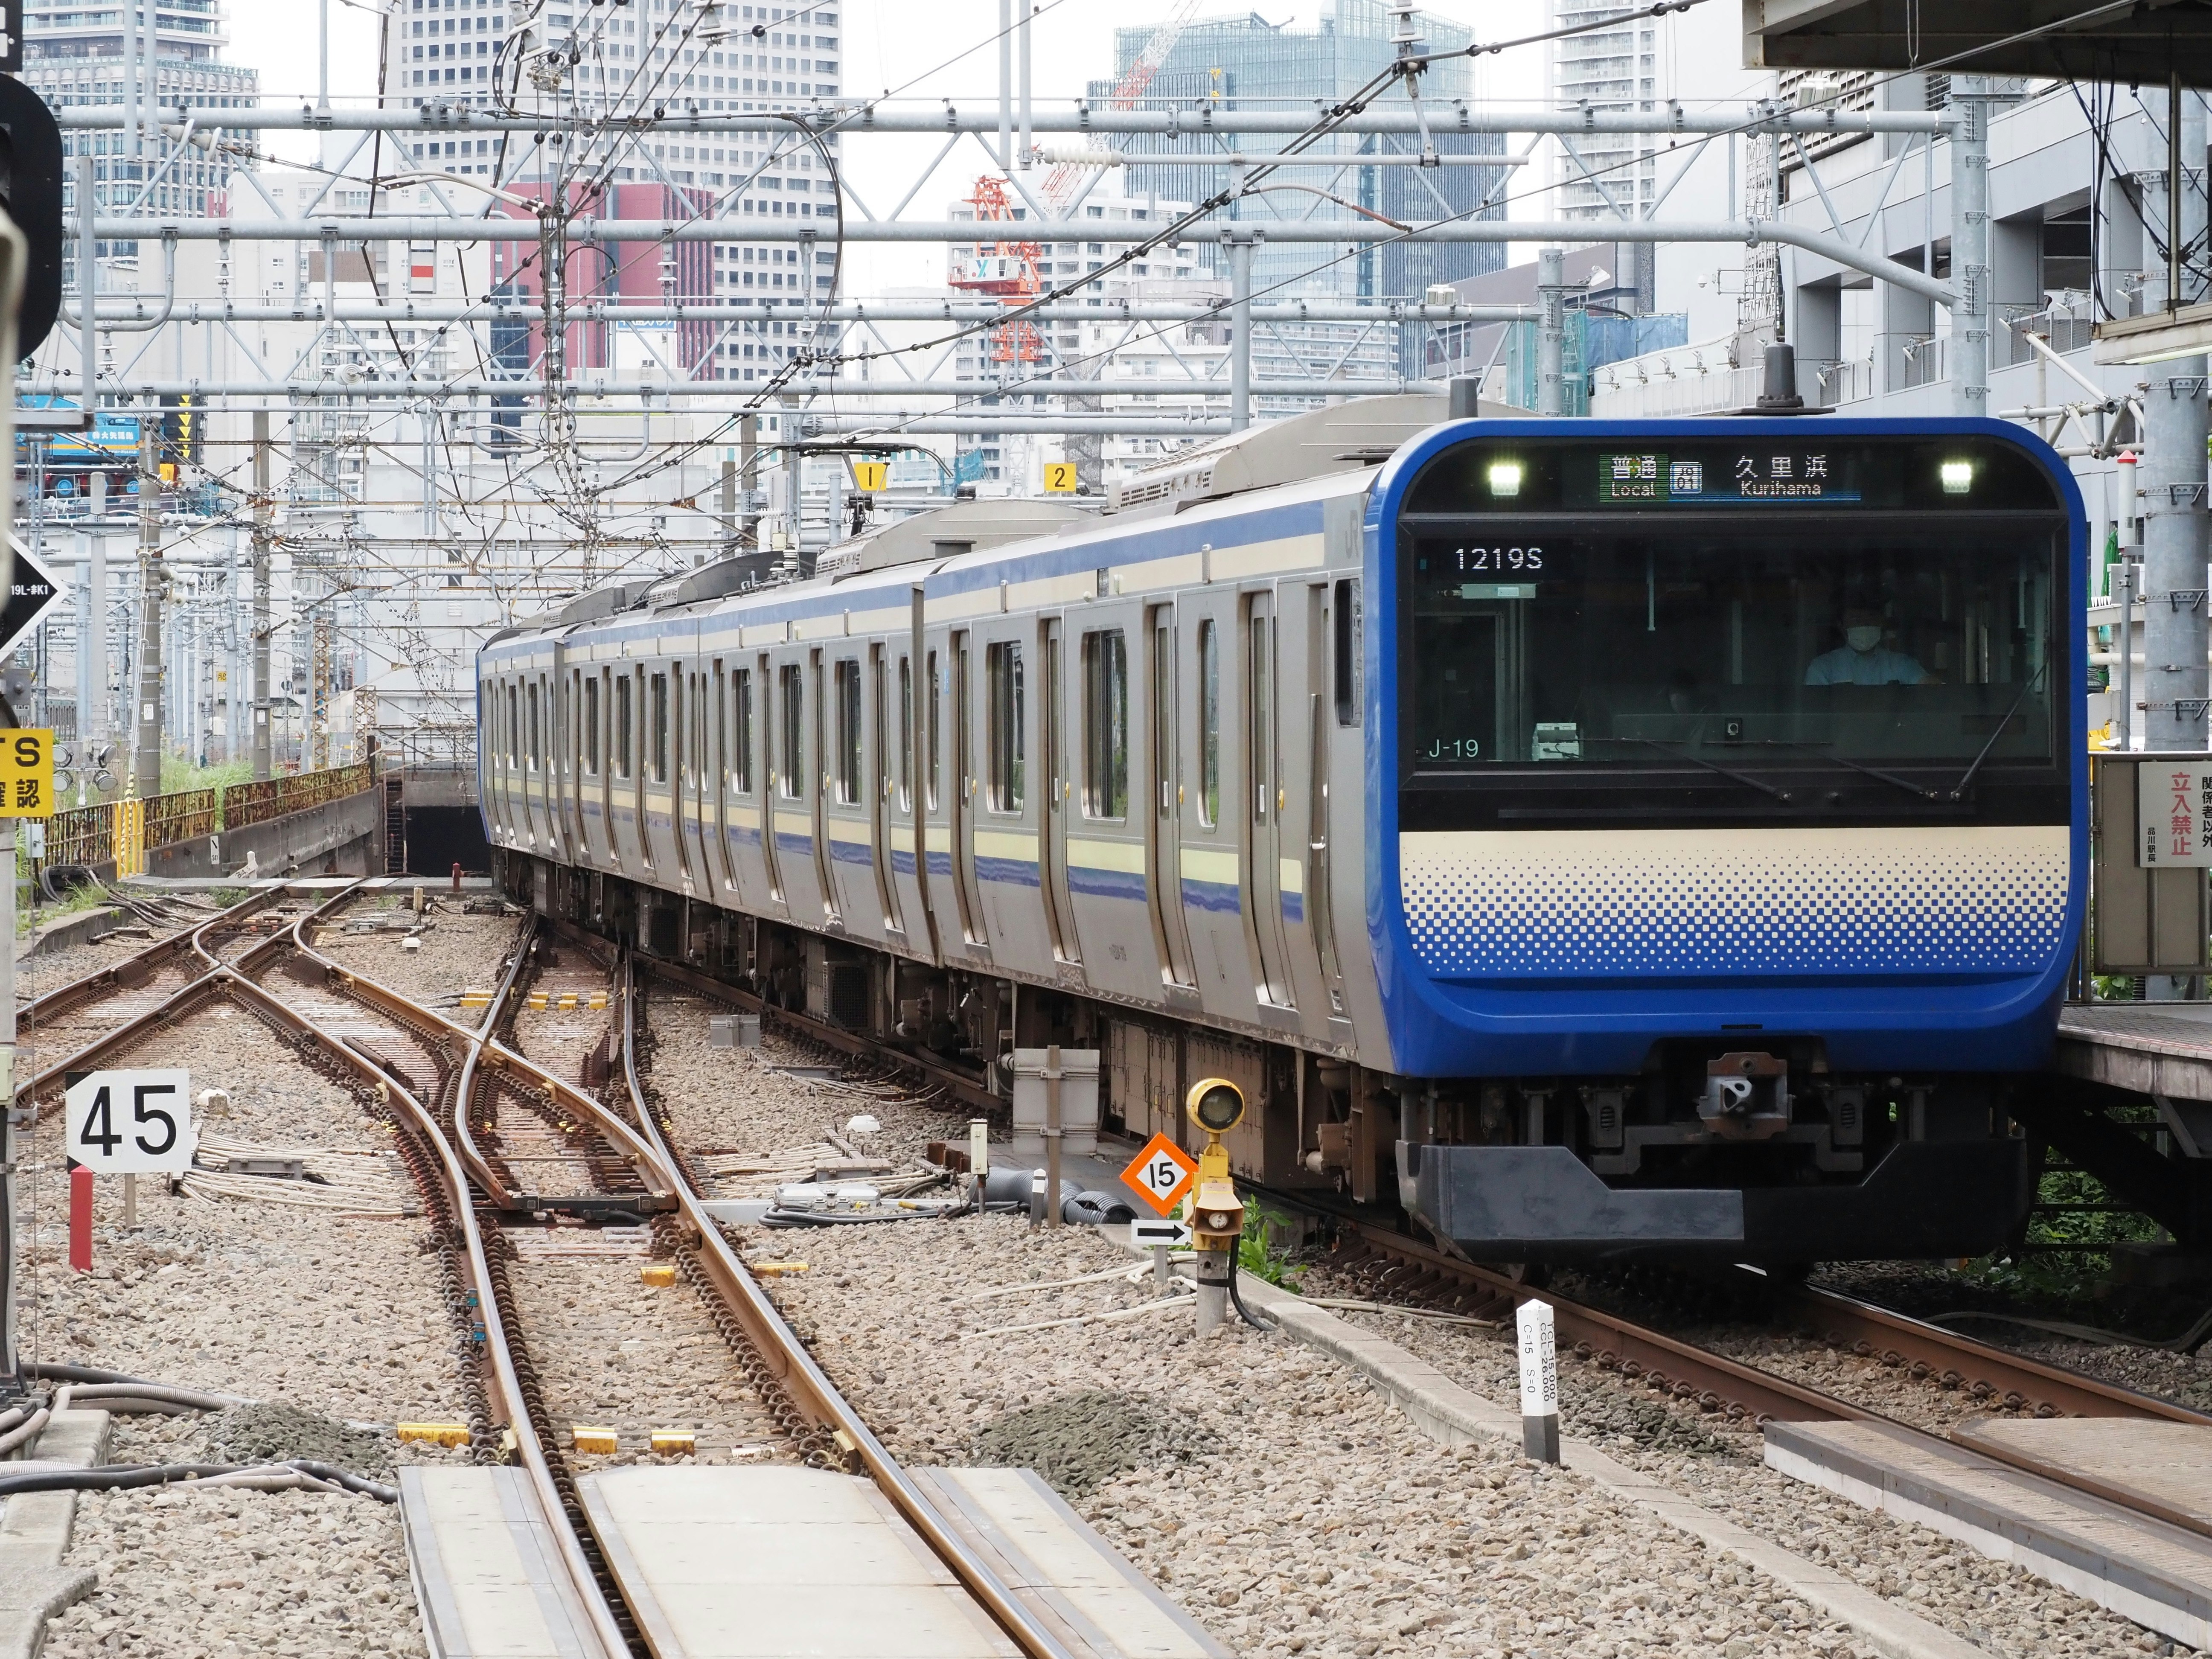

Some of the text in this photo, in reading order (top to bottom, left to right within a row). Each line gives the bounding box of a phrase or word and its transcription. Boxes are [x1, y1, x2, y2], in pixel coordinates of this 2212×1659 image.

[868, 467, 872, 487] 1
[1054, 467, 1066, 488] 2
[1611, 456, 1656, 479] 普通
[1735, 455, 1828, 478] 久里浜
[1612, 481, 1656, 497] Local
[1741, 481, 1822, 497] Kurihama
[1345, 509, 1359, 559] JR
[1455, 547, 1543, 569] 1219S
[1429, 739, 1479, 758] J-19
[2171, 772, 2192, 856] 立入禁止
[2147, 827, 2156, 862] 品川駅長
[80, 1084, 177, 1156] 45
[1149, 1161, 1176, 1189] 15
[1523, 1324, 1536, 1393] C=15 S=0
